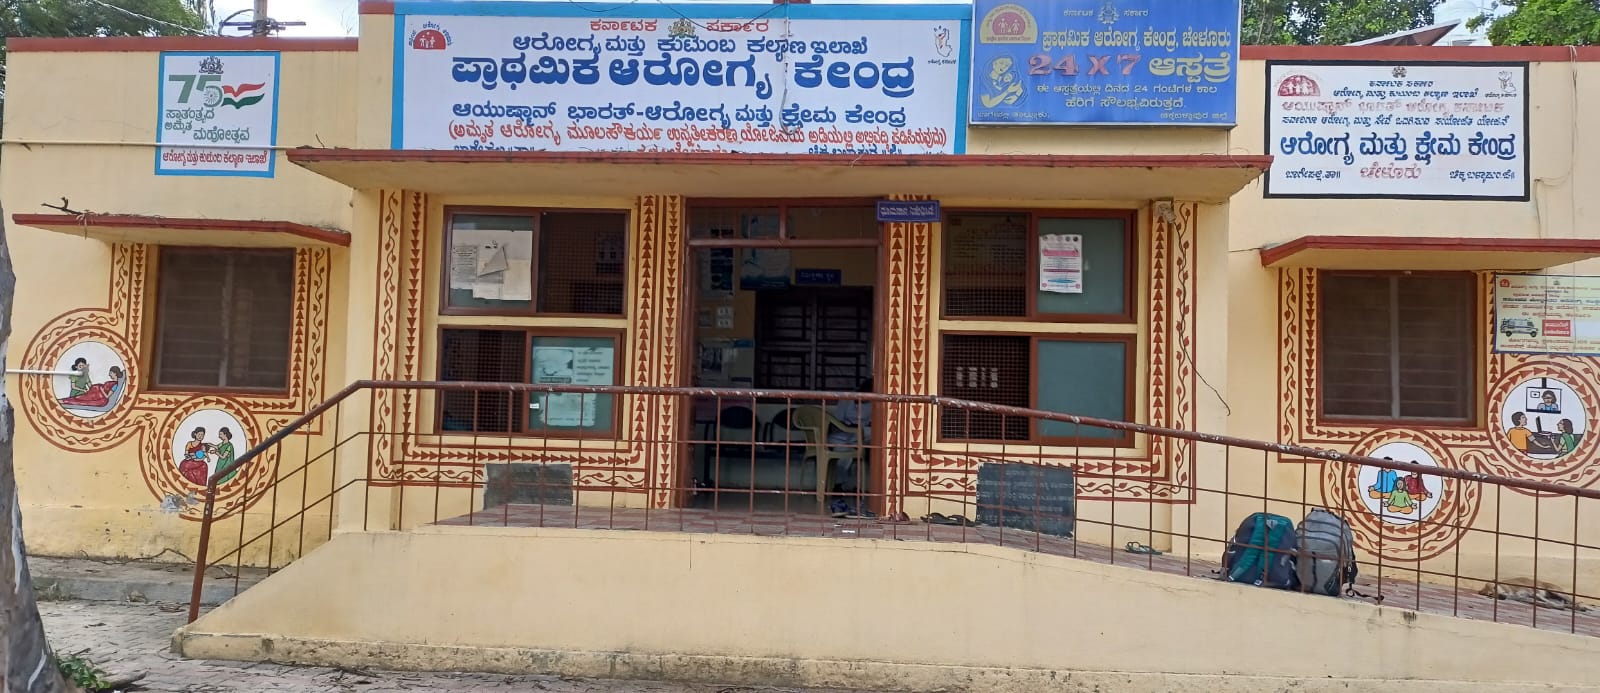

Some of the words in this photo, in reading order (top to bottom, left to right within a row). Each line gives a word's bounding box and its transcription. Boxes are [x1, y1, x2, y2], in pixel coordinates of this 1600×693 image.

[590, 19, 657, 32] ಕರ್ನಾಟಕ
[1042, 28, 1090, 52] ಪ್ರಾಥಮಿಕ
[1094, 27, 1141, 51] ಆರೋಗ್ಯ
[1182, 26, 1231, 47] ಚೇಳೂರು
[513, 32, 602, 55] ಆರೋಗ್ಯ
[605, 35, 646, 56] ಮತ್ತು
[657, 35, 735, 53] ಕುಟುಂಬ
[747, 36, 806, 62] ಕಲ್ಯಾಣ
[811, 36, 868, 54] ಇಲಾಖೆ
[451, 52, 600, 90] ಪ್ರಾಥಮಿಕ
[609, 53, 773, 99] ಆರೋಗ್ಯ
[794, 54, 915, 98] ಕೇಂದ್ರ
[1028, 54, 1079, 76] 24
[1117, 54, 1142, 76] 7
[1148, 51, 1231, 82] ಆಸ್ಪತ್ರೆ
[168, 74, 224, 107] 75
[1066, 97, 1094, 108] ಹೆರಿಗೆ
[1134, 84, 1148, 93] 24
[1333, 87, 1364, 99] ಆರೋಗ್ಯ
[1366, 90, 1386, 100] ಮತ್ತು
[1452, 87, 1479, 98] ಇಲಾಖೆ
[453, 100, 557, 126] ಆಯುಷ್ಮಾನ್
[736, 106, 773, 128] ಮತ್ತು
[782, 104, 836, 128] ಕ್ಷೇಮ
[845, 105, 906, 128] ಕೇಂದ್ರ
[193, 126, 250, 144] ಮಹೋತ್ಸವ
[500, 120, 561, 145] ಆರೋಗ್ಯ
[808, 126, 853, 148] ಅಡಿಯಲ್ಲಿ
[1280, 131, 1355, 165] ಆರೋಗ್ಯ
[1359, 132, 1408, 160] ಮತ್ತು
[1415, 131, 1461, 165] ಕ್ಷೇಮ
[1468, 131, 1516, 160] ಕೇಂದ್ರ
